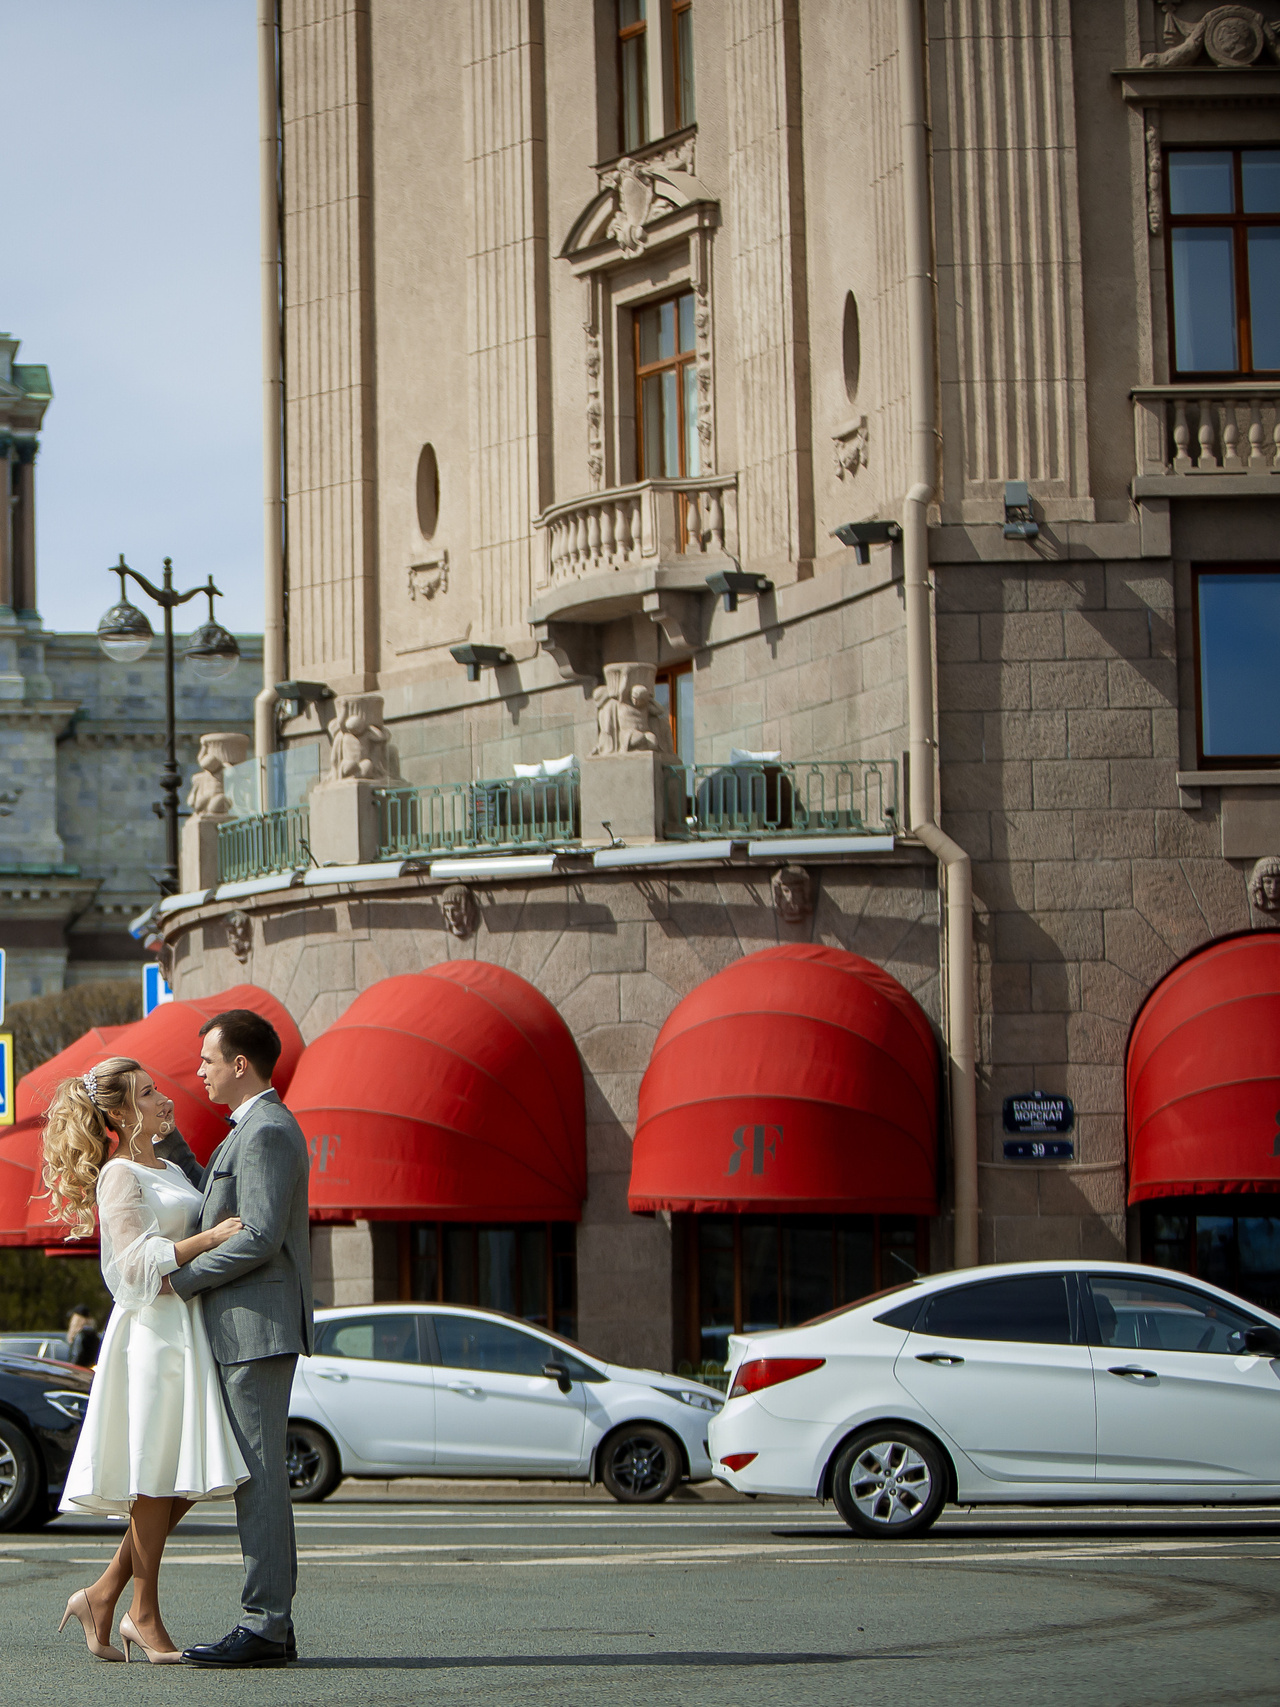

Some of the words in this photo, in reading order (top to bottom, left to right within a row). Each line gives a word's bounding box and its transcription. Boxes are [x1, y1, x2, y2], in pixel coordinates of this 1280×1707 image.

[1013, 1101, 1064, 1111] БОЛЬШАЯ
[1015, 1110, 1062, 1121] МОРСКАЯ
[1032, 1143, 1045, 1157] 39
